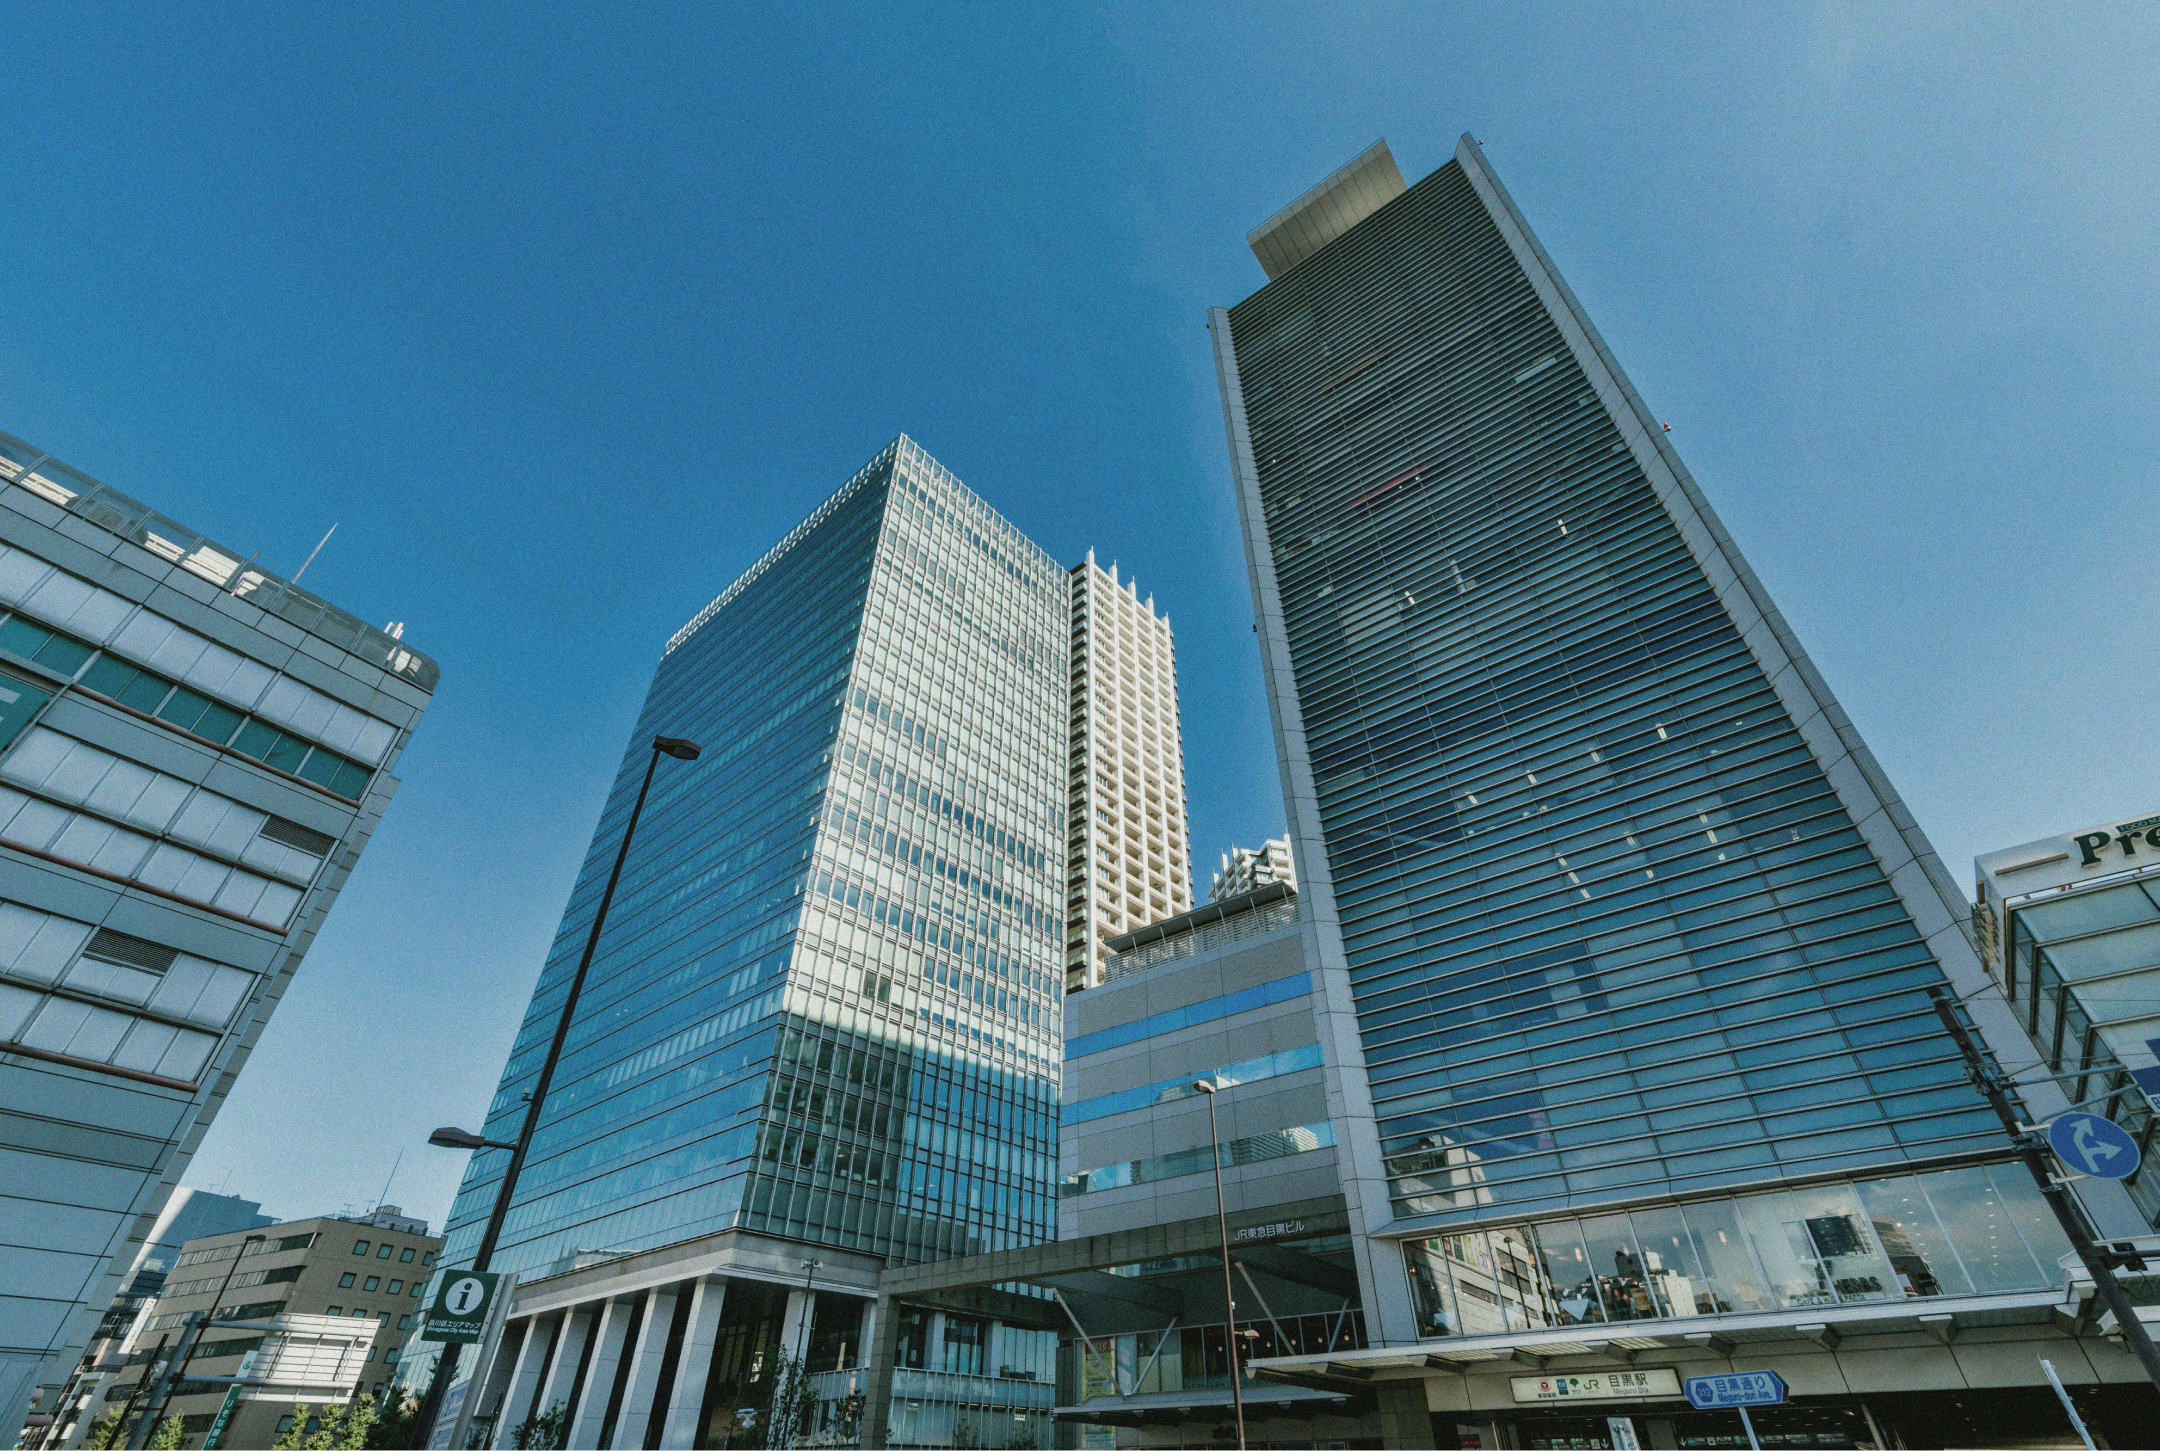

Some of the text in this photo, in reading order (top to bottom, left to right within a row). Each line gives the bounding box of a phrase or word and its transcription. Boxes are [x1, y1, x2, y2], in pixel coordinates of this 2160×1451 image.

[2120, 820, 2148, 832] FOOD
[1234, 1220, 1305, 1241] JR東急目黒ビル
[1583, 1379, 1600, 1390] JR
[1608, 1373, 1648, 1388] 目黒駅
[1714, 1375, 1766, 1393] 目黒通り
[1613, 1388, 1637, 1396] Meguro
[1697, 1387, 1712, 1397] 312
[1757, 1390, 1773, 1399] Ave.
